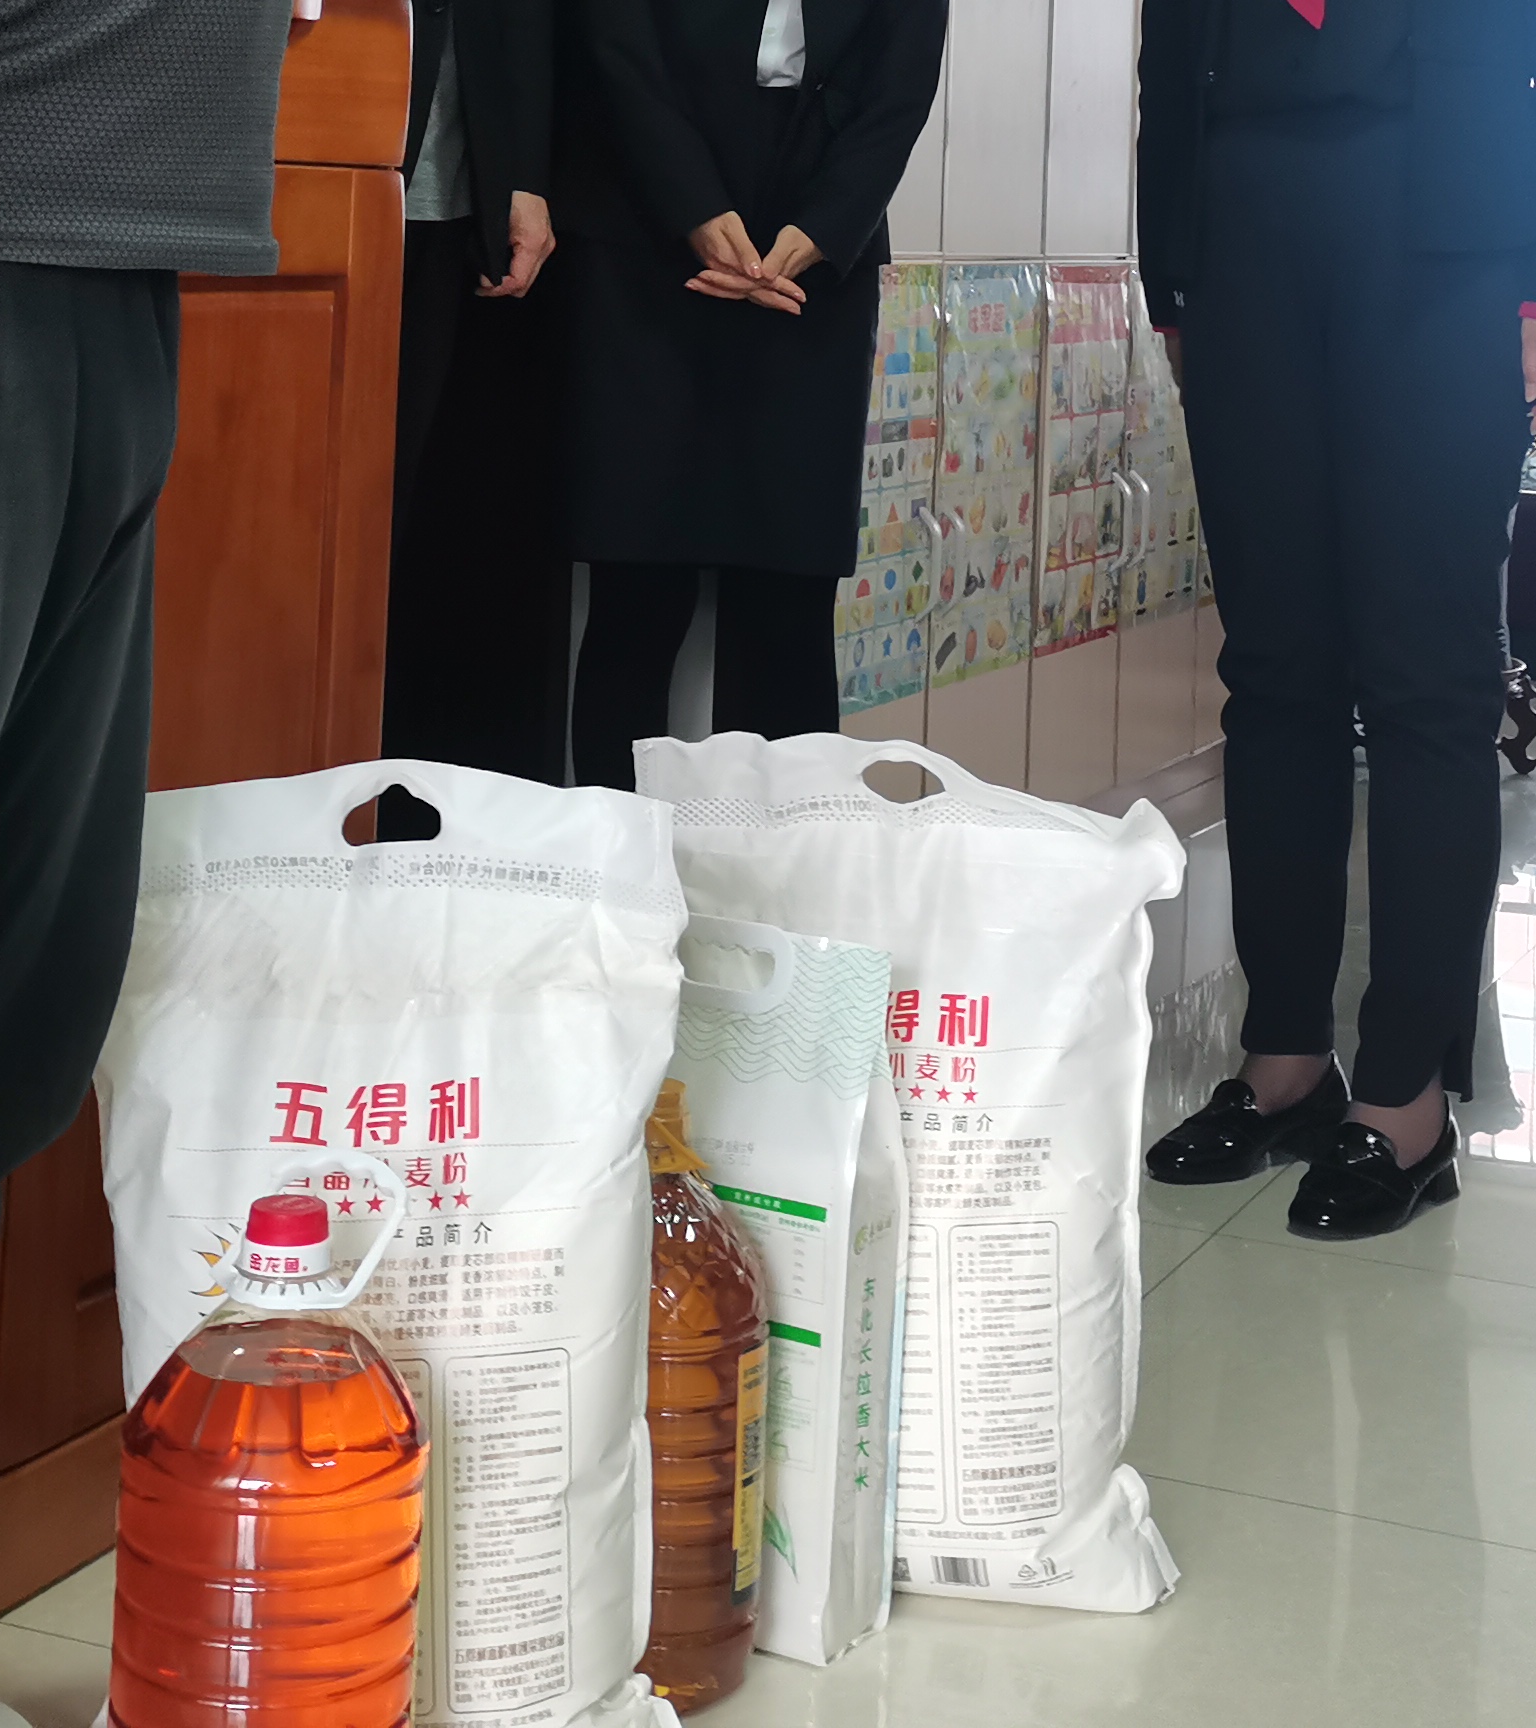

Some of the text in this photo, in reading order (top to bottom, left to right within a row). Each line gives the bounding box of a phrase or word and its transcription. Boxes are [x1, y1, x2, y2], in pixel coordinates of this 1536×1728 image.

[270, 1075, 482, 1147] 五得利
[249, 1253, 302, 1274] 金龙鱼
